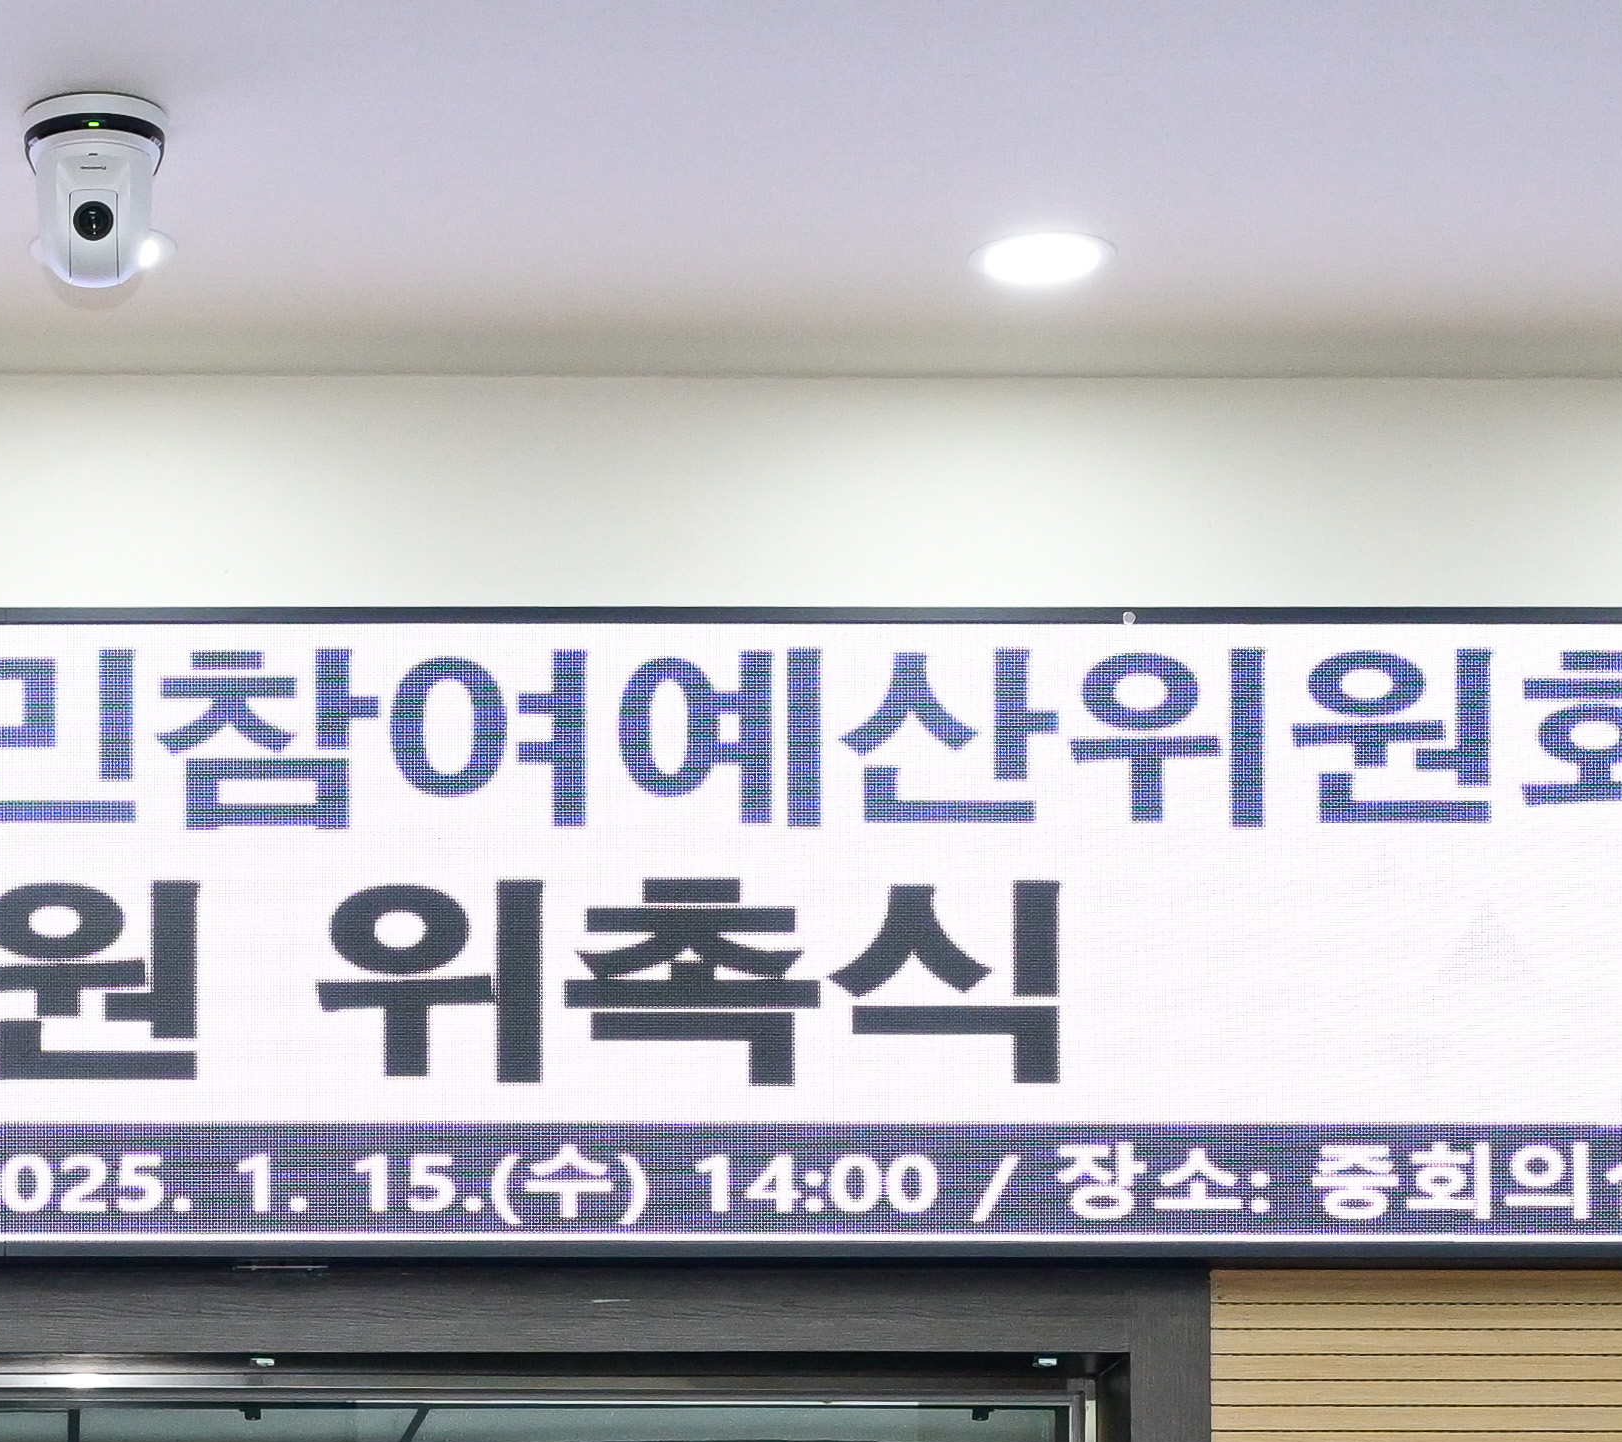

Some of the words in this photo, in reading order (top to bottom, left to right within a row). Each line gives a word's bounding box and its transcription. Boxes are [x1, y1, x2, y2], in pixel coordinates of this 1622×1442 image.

[316, 877, 1060, 1086] 위촉식
[235, 1153, 307, 1214] 1.
[354, 1143, 648, 1224] 15.(수)
[694, 1153, 938, 1214] 14:00
[1057, 1142, 1270, 1221] 장소:
